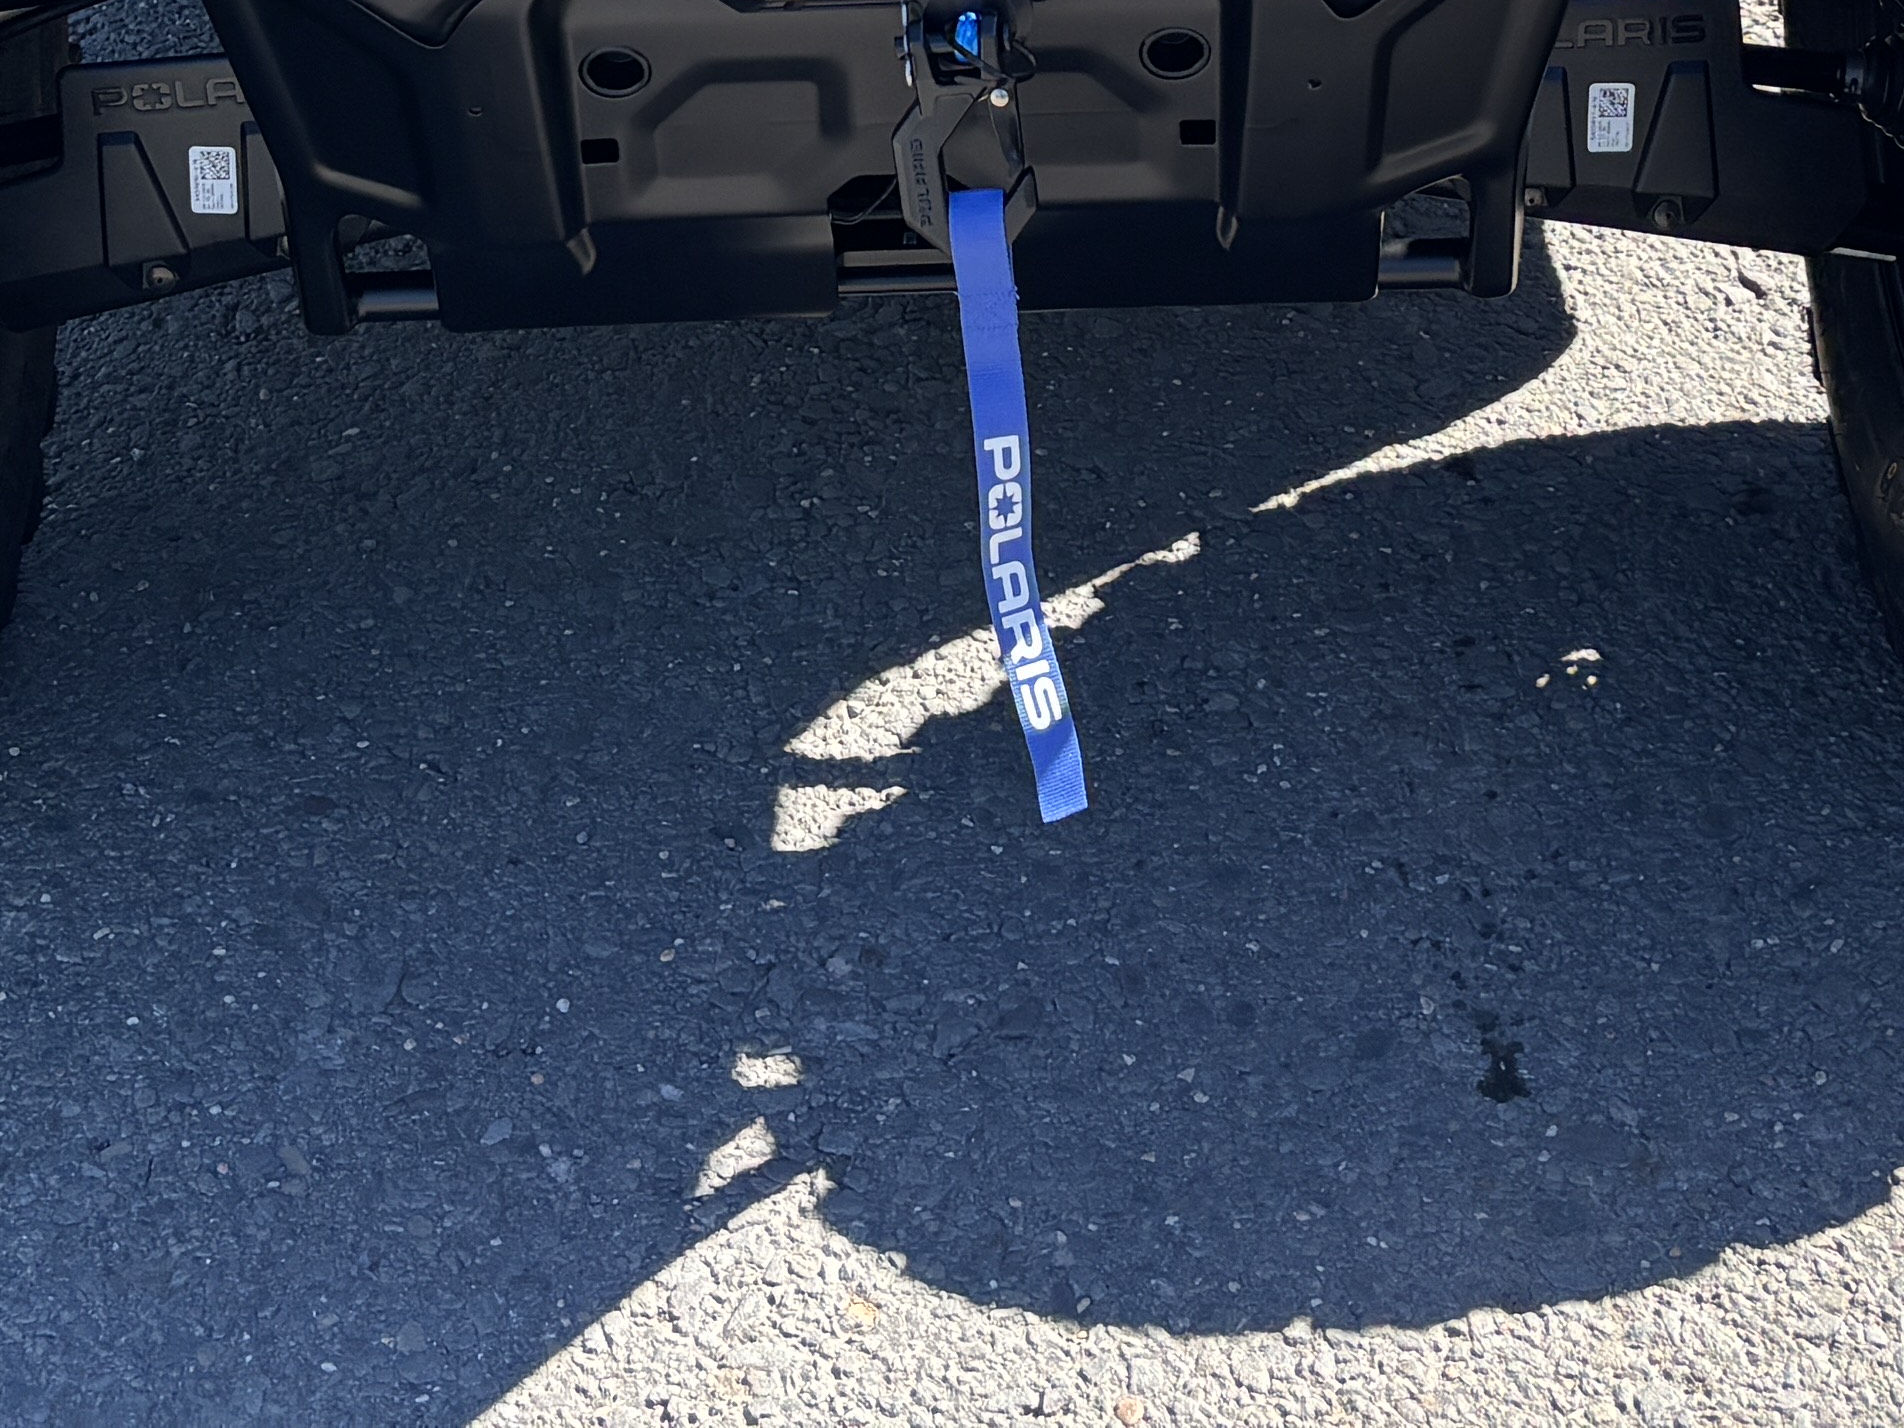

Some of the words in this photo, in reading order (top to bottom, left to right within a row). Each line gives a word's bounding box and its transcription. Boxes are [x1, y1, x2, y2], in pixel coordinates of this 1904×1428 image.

[1555, 13, 1706, 49] ARIS
[90, 77, 246, 116] POLA
[983, 434, 1063, 731] POLARIS
